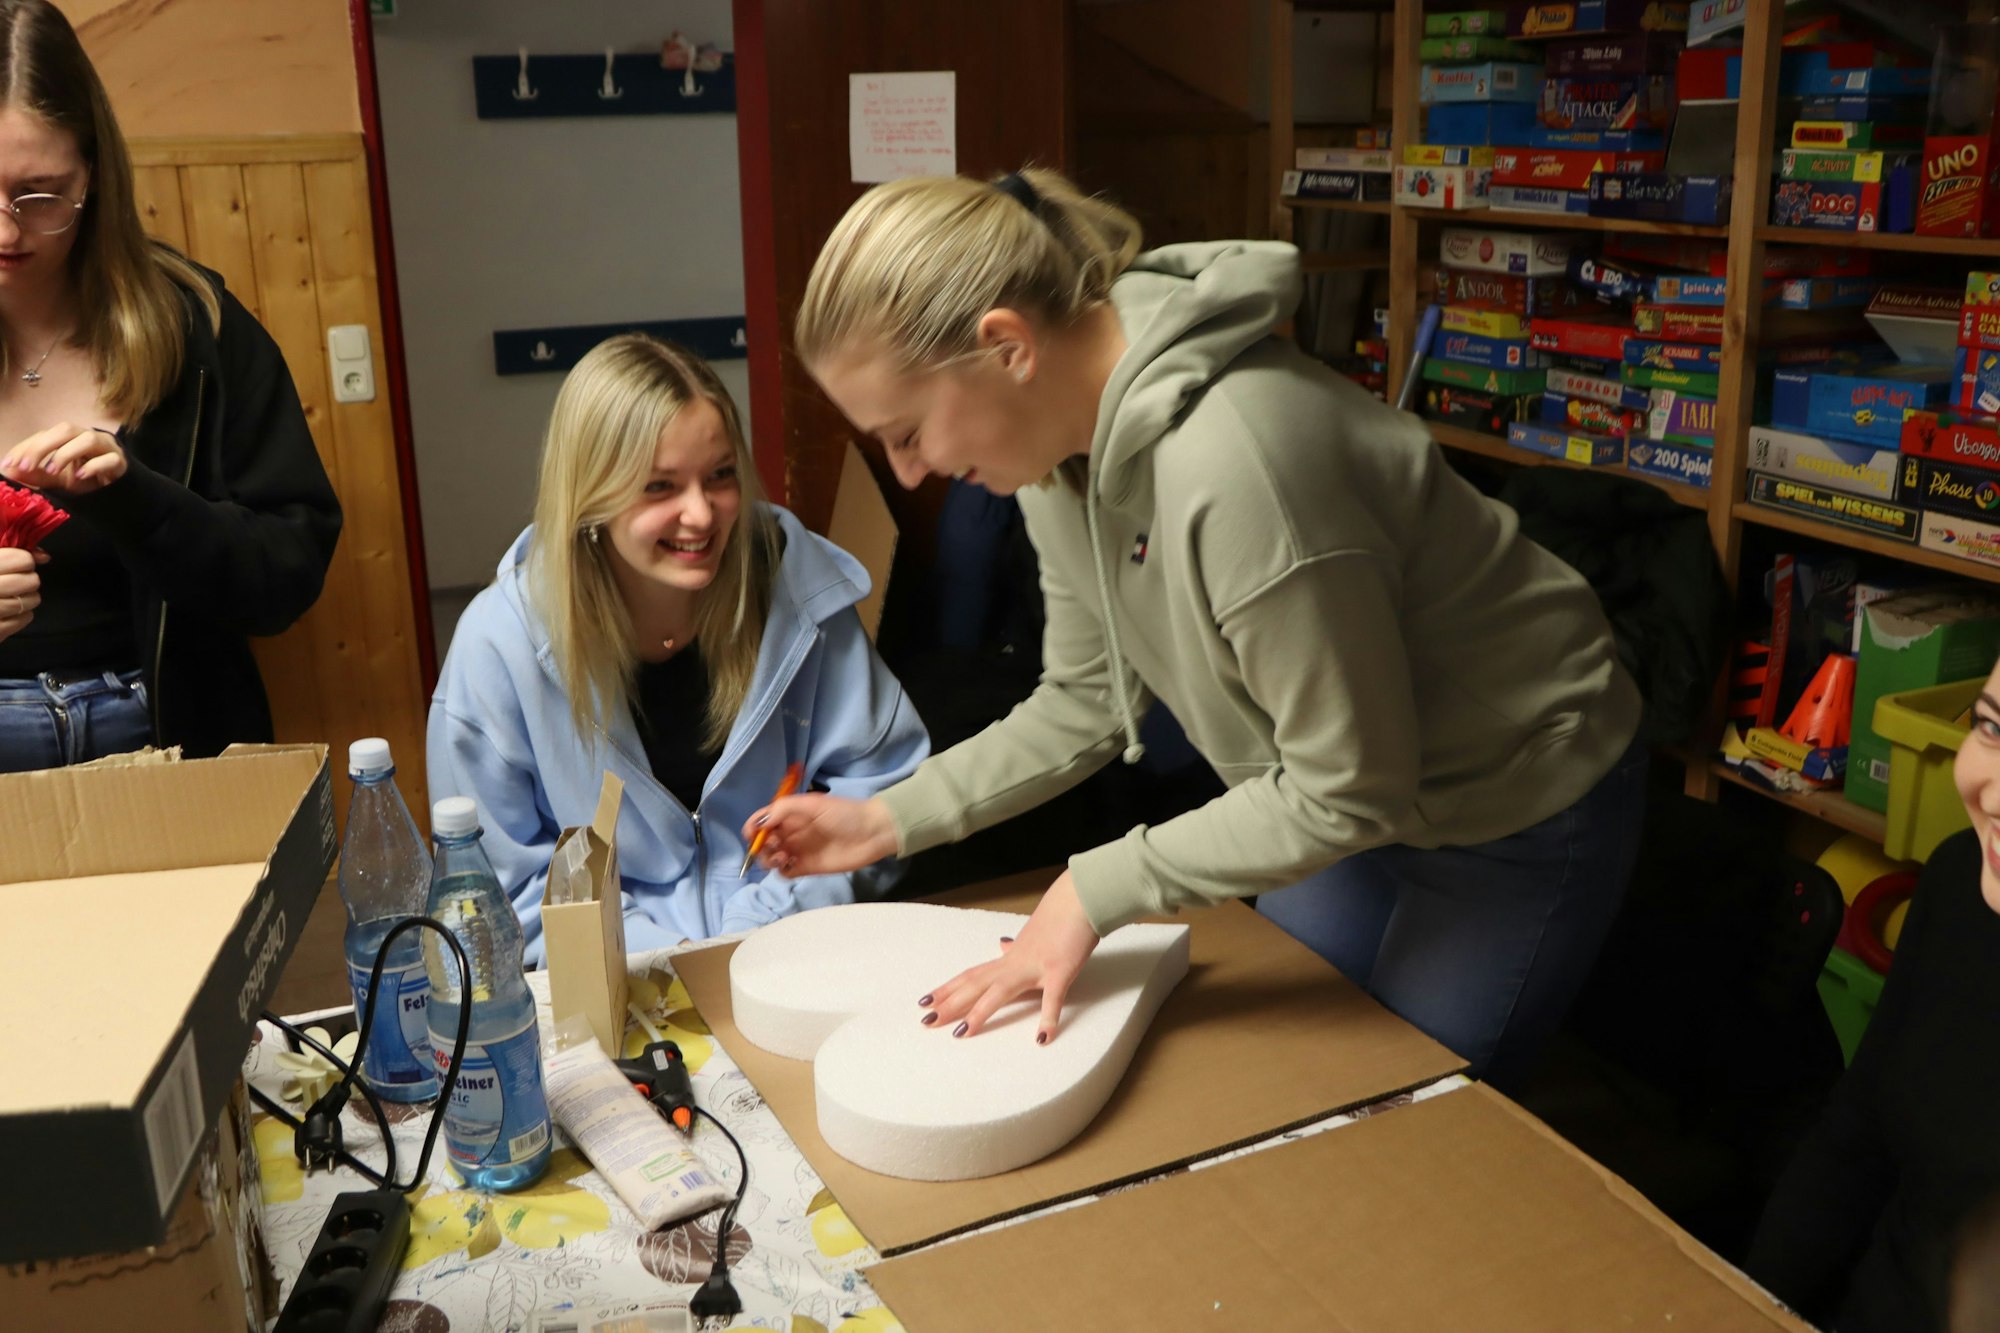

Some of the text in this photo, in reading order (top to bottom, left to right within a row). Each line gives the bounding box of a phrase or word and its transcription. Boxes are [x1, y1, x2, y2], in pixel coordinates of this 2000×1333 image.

[1562, 98, 1617, 121] ATTACKE
[1811, 159, 1850, 173] ACTIVITY
[1927, 144, 1979, 180] UNO
[1810, 193, 1857, 214] DOG
[1580, 259, 1623, 286] CLUEDO
[1456, 276, 1504, 300] ANDOR
[1653, 447, 1679, 469] 200
[1794, 453, 1889, 492] Topminos
[1929, 471, 1974, 500] Phase
[1983, 489, 1994, 502] 10
[1775, 481, 1815, 504] SPIEL
[1832, 495, 1906, 528] WISSENS
